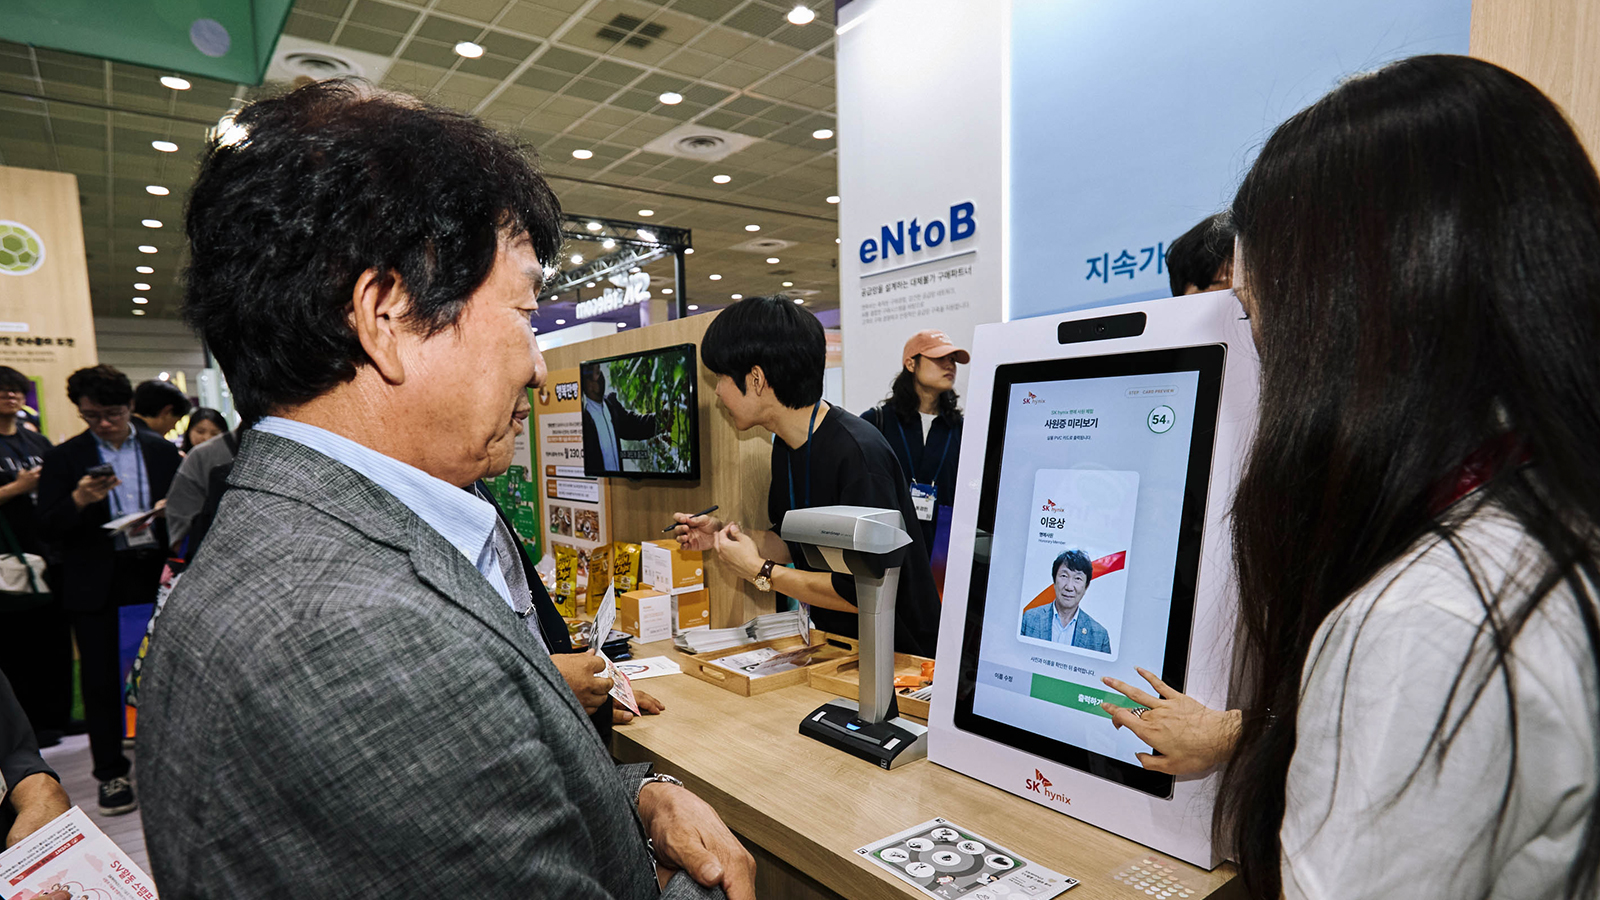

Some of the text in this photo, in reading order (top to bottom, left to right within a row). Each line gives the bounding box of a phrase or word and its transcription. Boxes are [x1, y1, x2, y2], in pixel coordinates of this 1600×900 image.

[859, 202, 976, 264] eNtoB
[1086, 242, 1166, 283] 지속가
[861, 266, 973, 297] 공급망을 설계하는 대체불가 구매파트너
[1044, 418, 1099, 429] 사원증 미리보기
[1040, 517, 1066, 529] 이윤상
[1043, 659, 1055, 667] 이름을
[1055, 662, 1068, 670] 확인한
[994, 672, 1003, 680] 이름
[1078, 694, 1103, 706] 출력하기
[1025, 778, 1071, 805] SK hynix
[110, 860, 137, 884] SV활동
[131, 882, 154, 900] 스탬프
